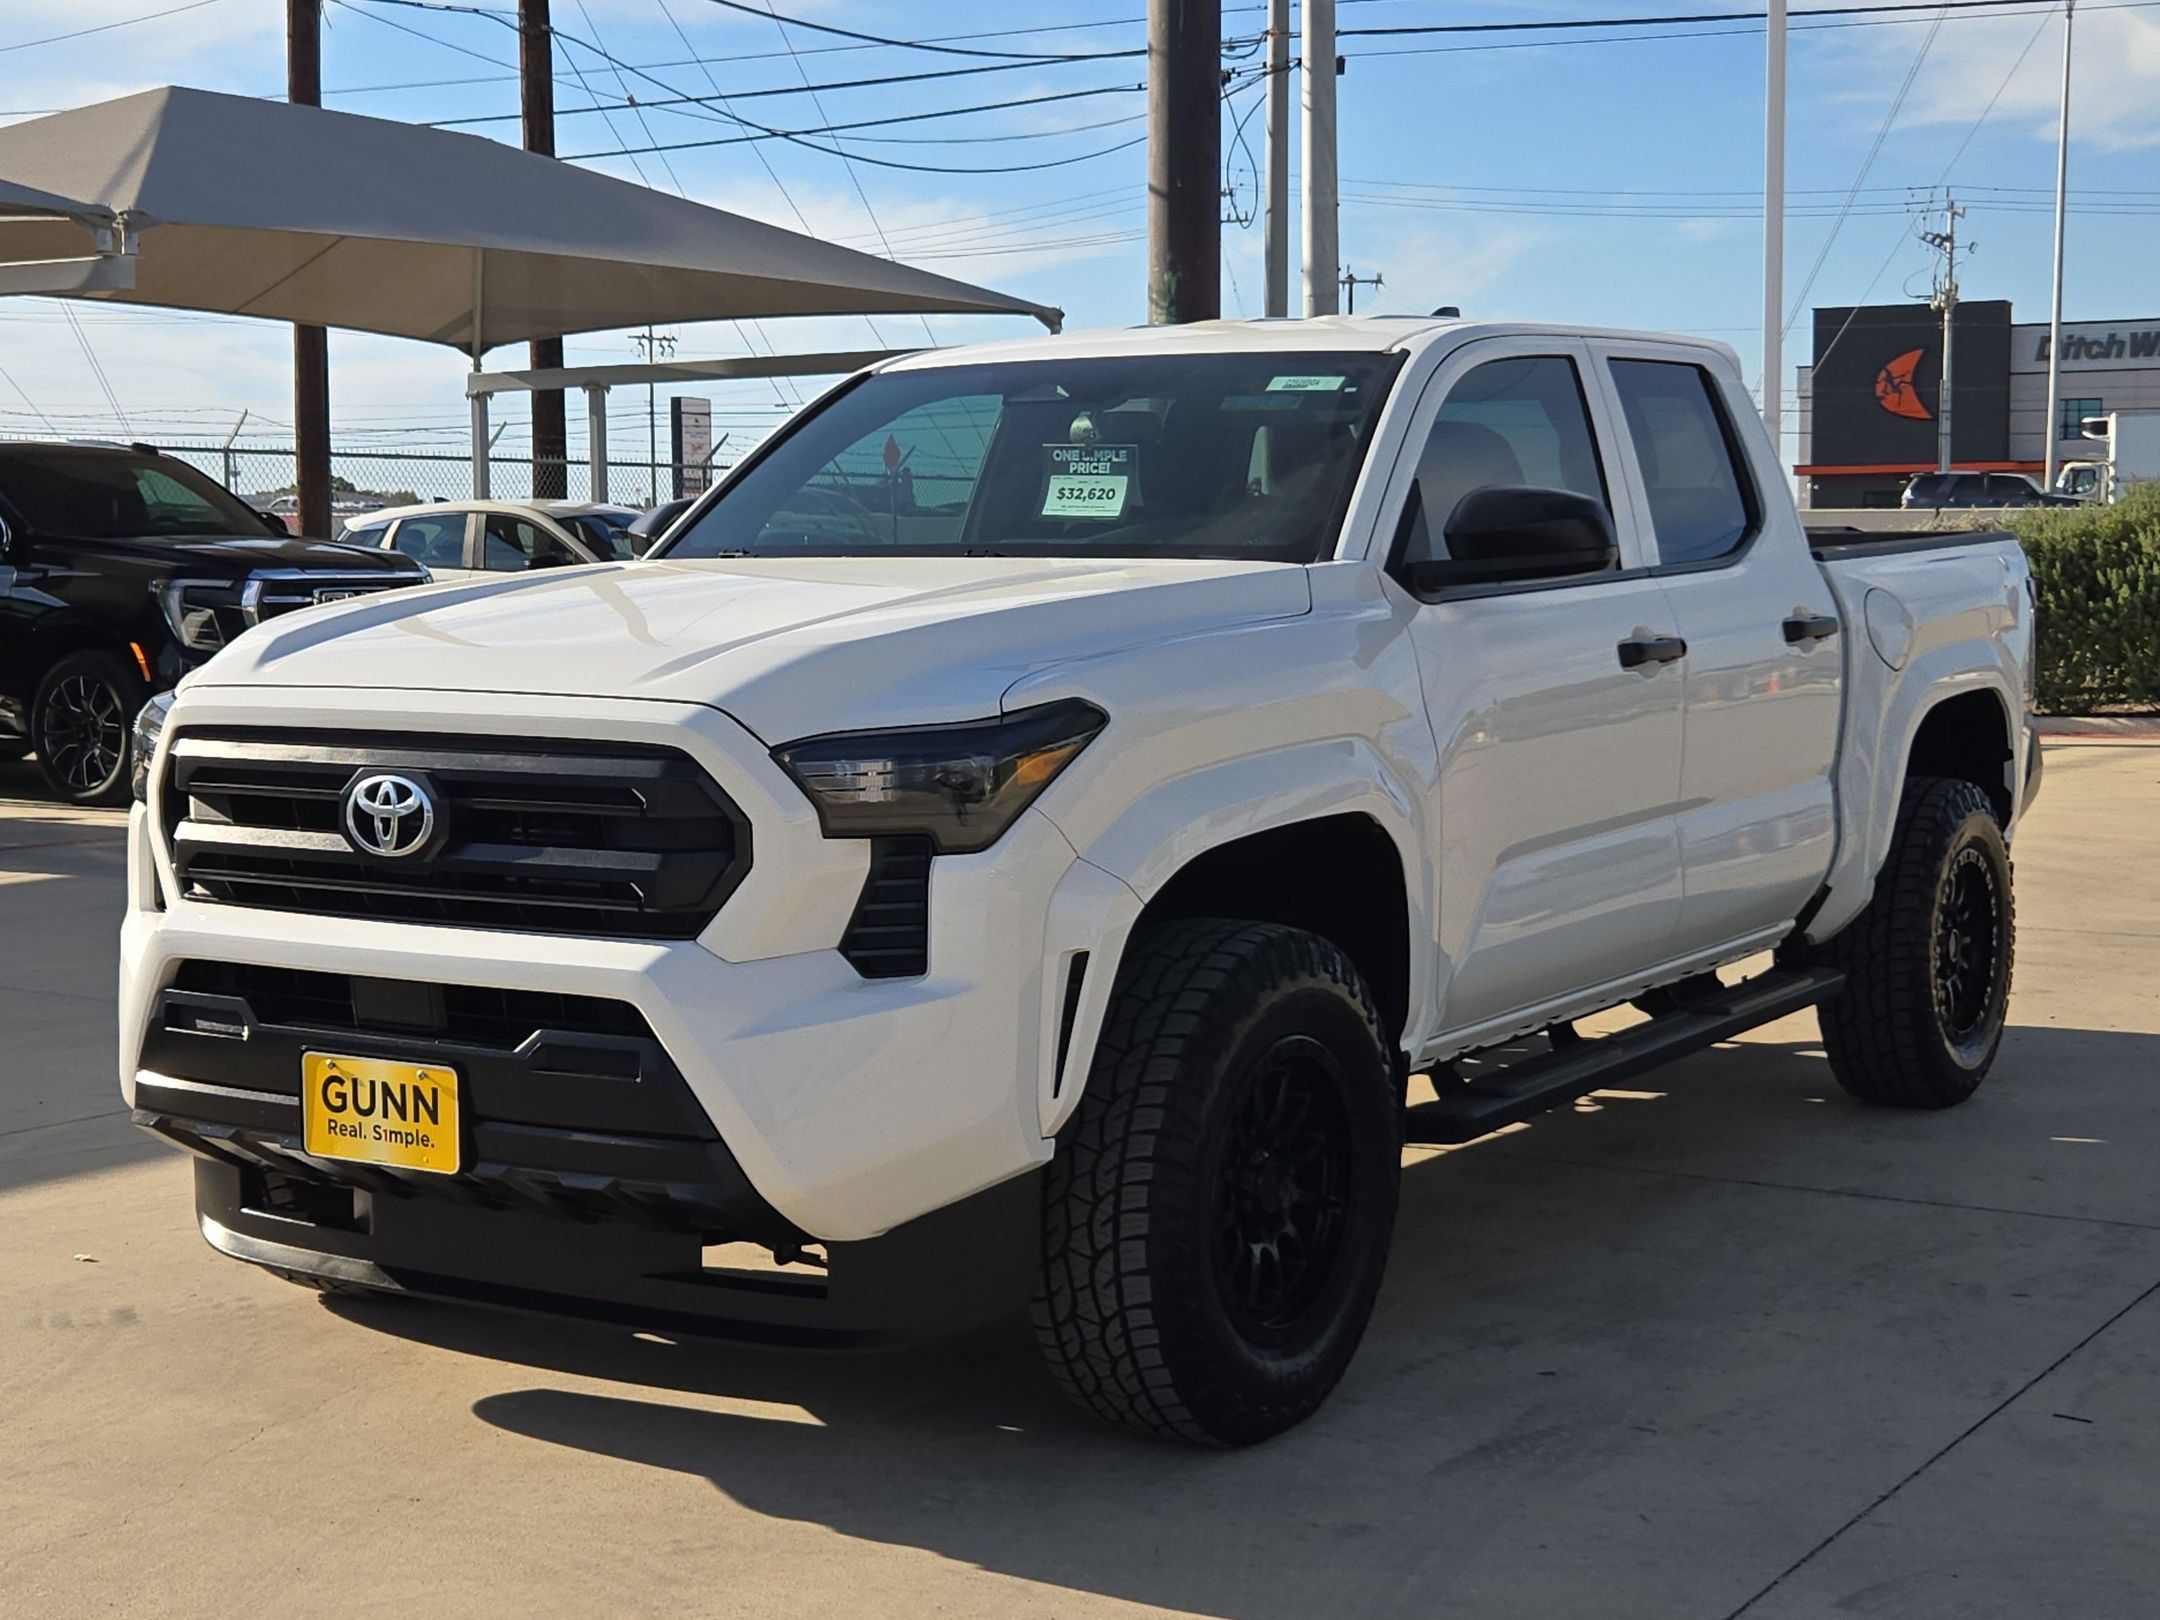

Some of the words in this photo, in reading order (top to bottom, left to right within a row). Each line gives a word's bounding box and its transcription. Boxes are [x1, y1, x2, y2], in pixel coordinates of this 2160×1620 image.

[2034, 332, 2126, 361] Ditch
[1052, 449, 1080, 462] ONE
[1081, 450, 1128, 462] SMPLE
[1069, 462, 1111, 474] PRICE!
[1056, 487, 1116, 502] $32,620
[321, 1075, 439, 1125] GUNN
[327, 1118, 367, 1140] Real.
